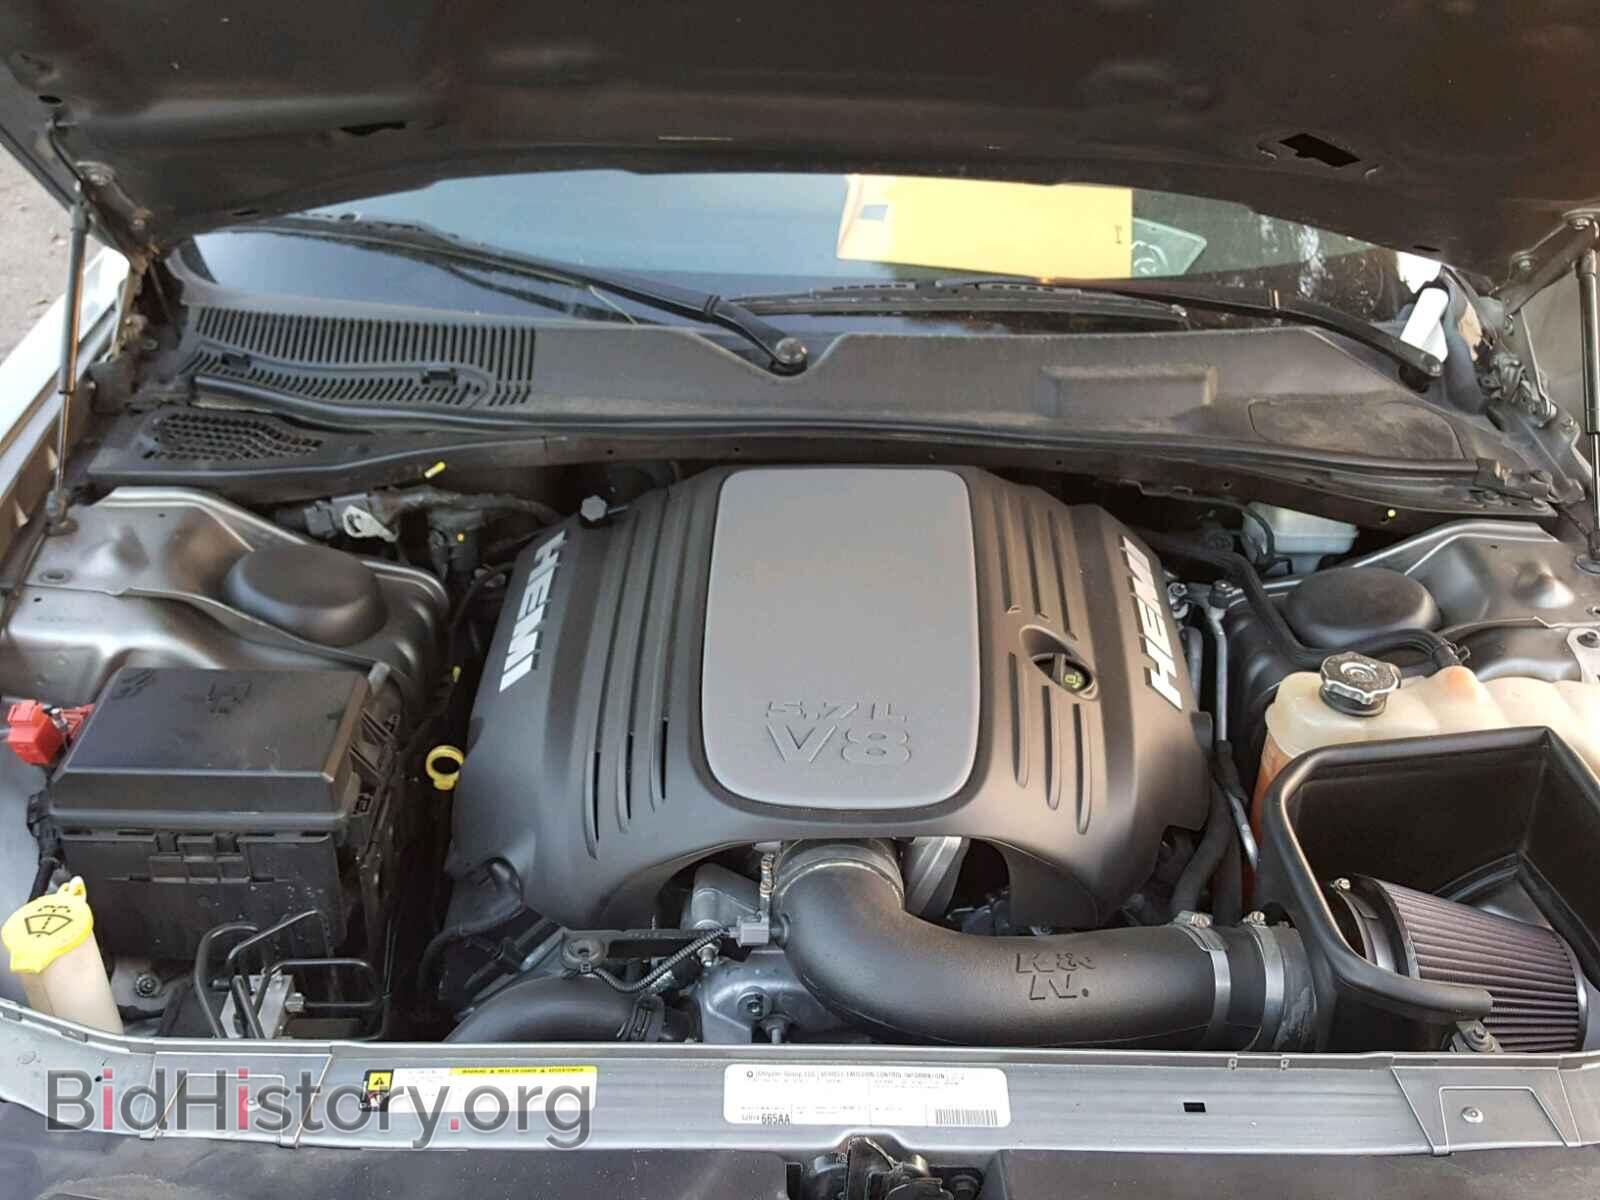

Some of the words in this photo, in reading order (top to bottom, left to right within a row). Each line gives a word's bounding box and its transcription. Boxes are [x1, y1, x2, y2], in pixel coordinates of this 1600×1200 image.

[499, 529, 567, 692] HEMI
[1121, 535, 1184, 711] HEMI
[765, 724, 912, 765] V8
